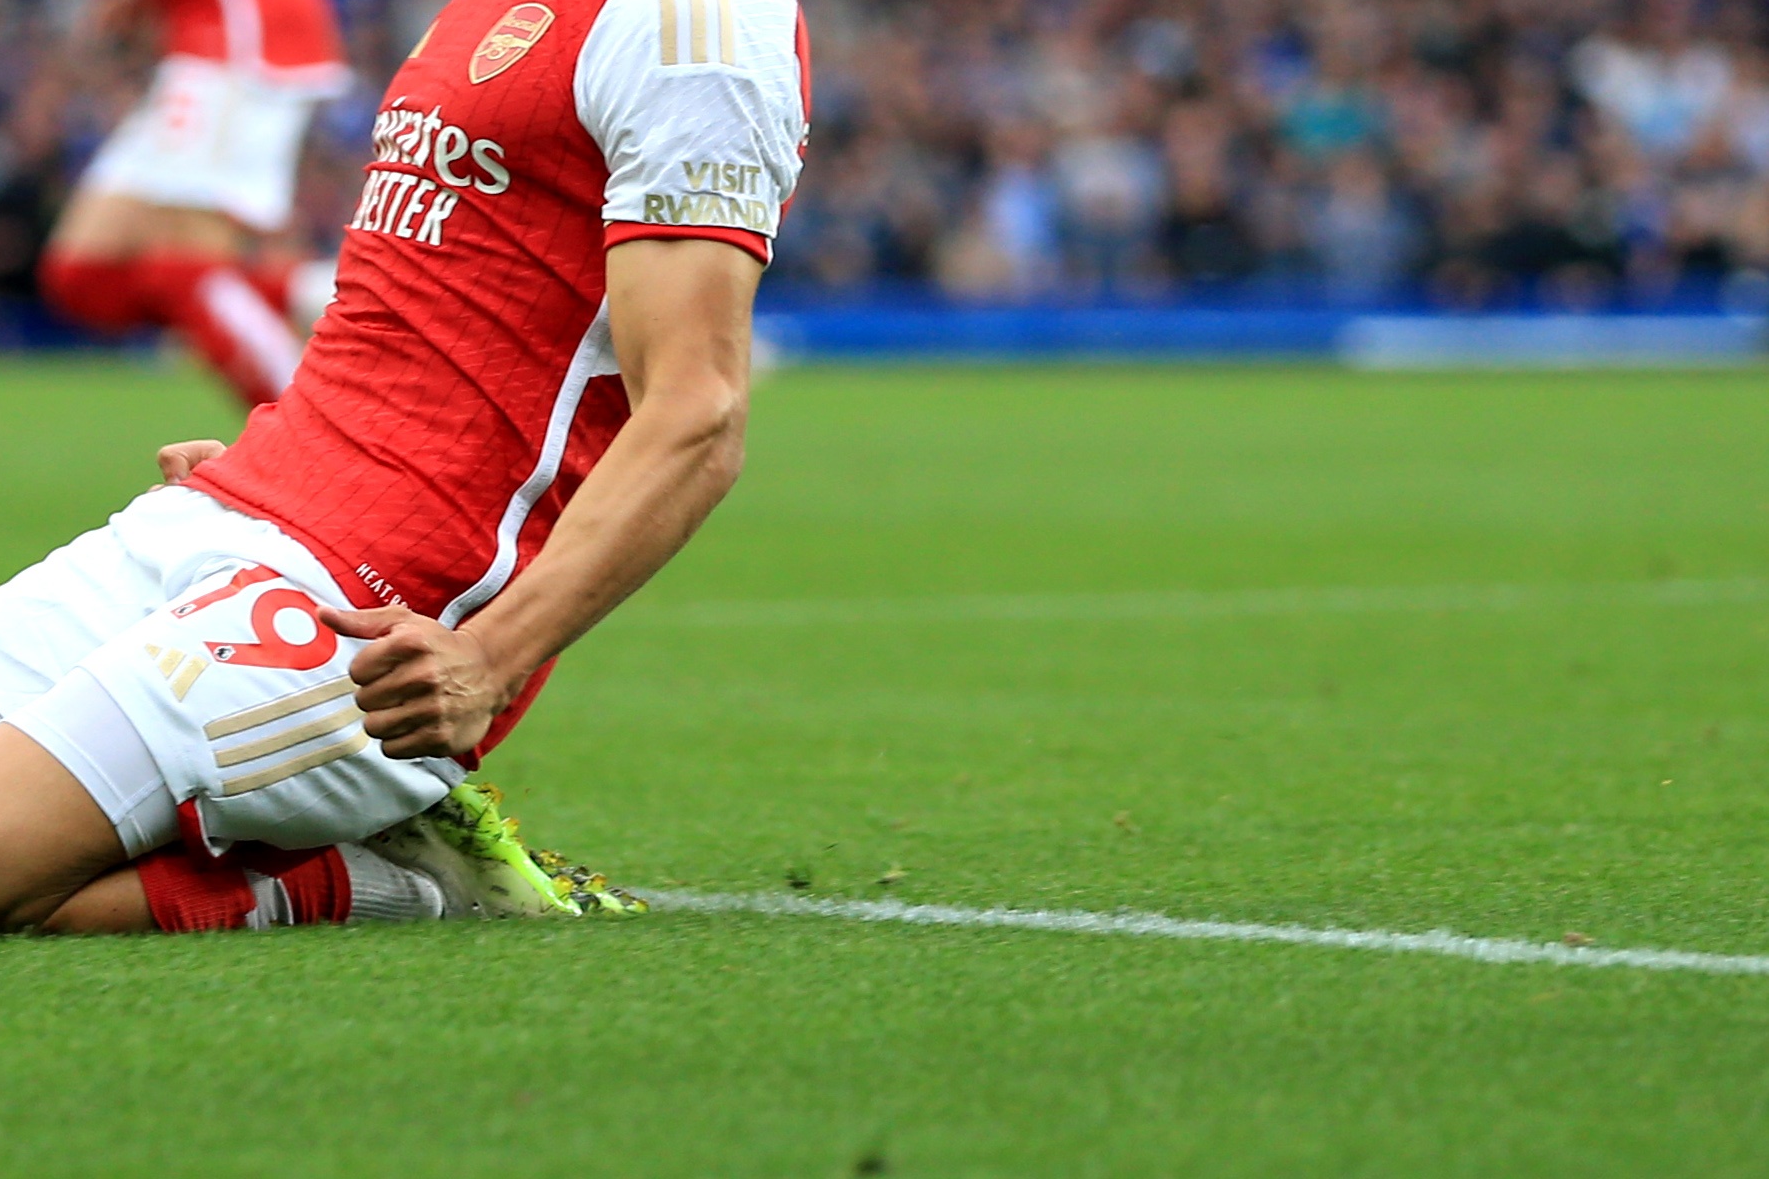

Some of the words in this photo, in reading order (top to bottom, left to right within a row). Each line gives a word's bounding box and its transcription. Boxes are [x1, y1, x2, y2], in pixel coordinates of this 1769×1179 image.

[682, 161, 761, 195] VISIT
[643, 194, 773, 231] RWAND
[171, 564, 338, 671] 19
